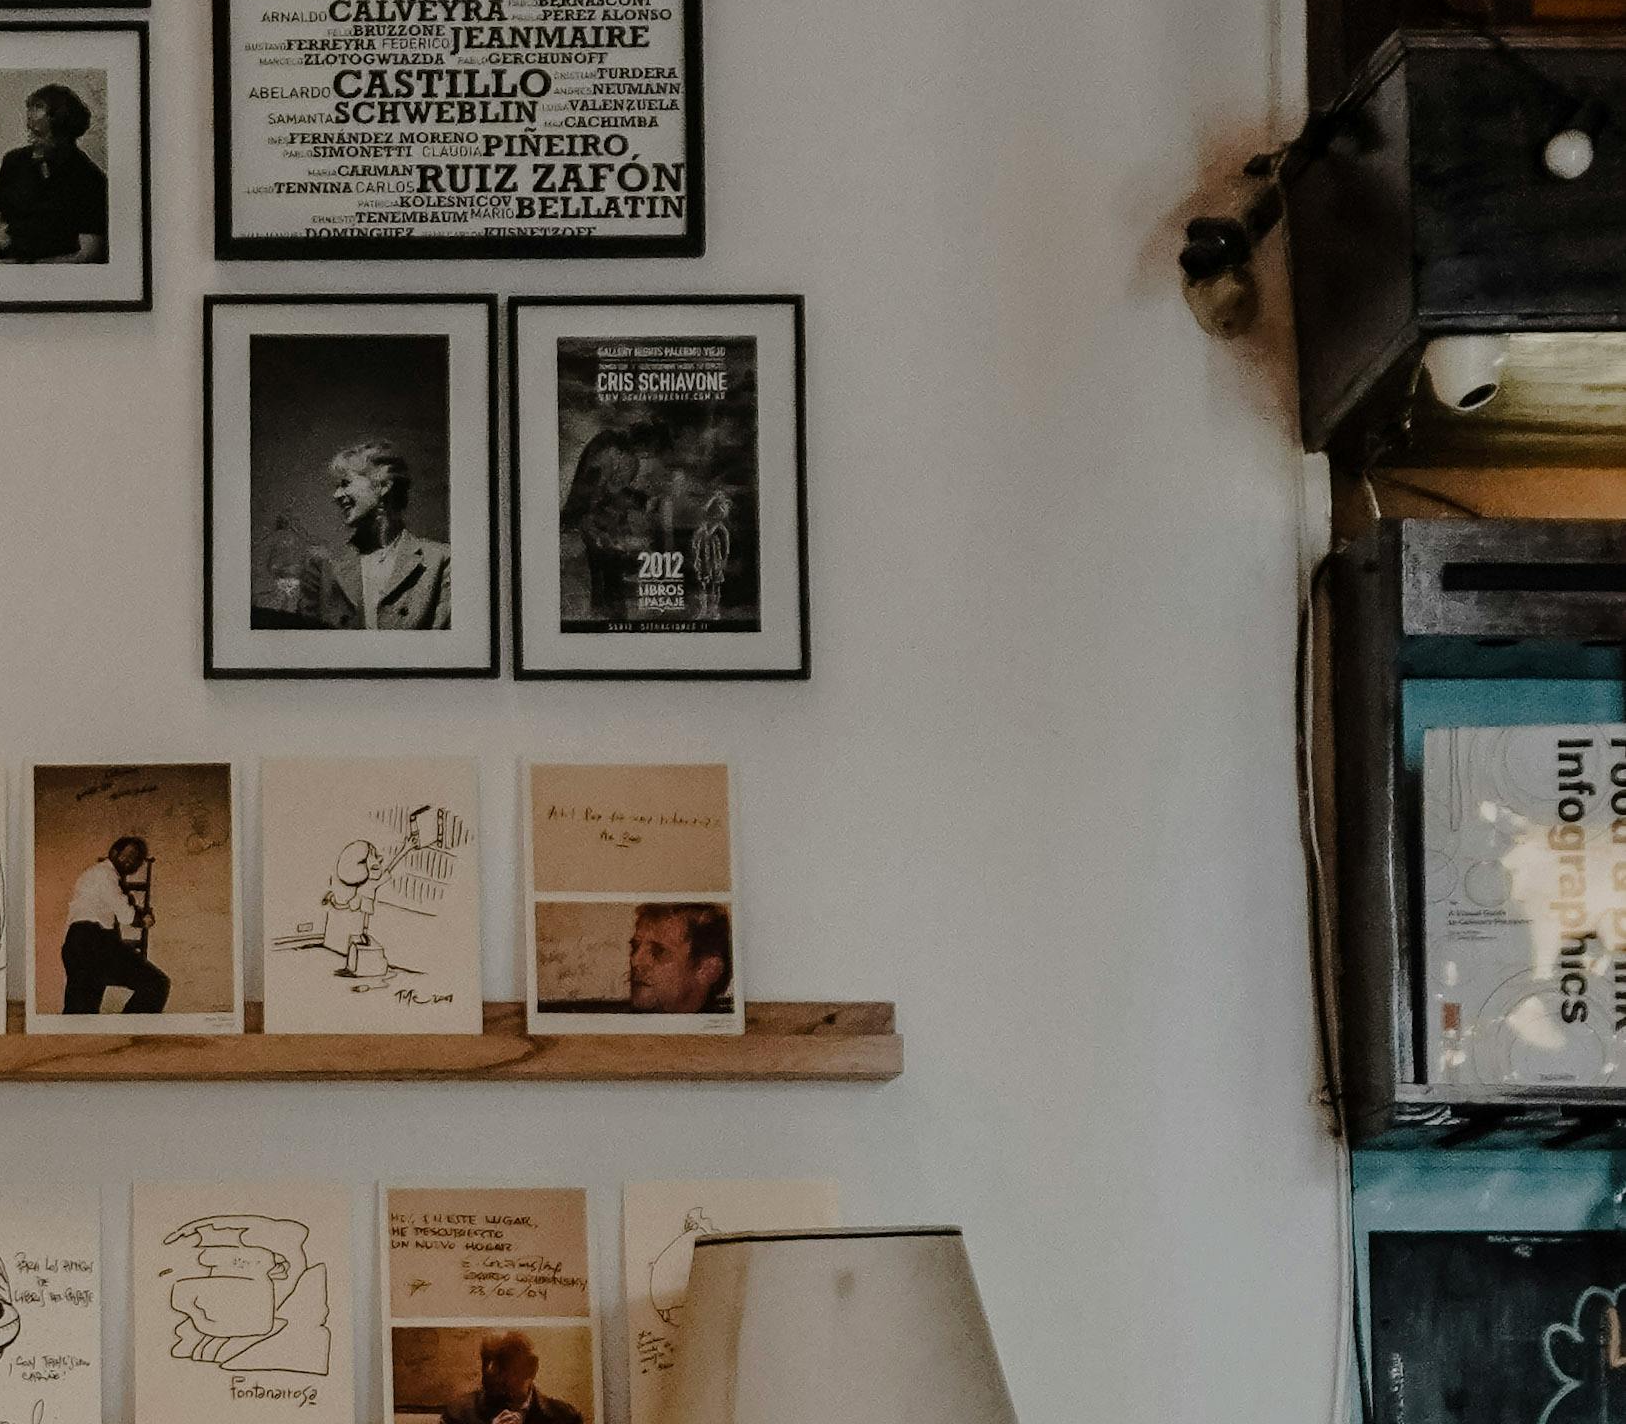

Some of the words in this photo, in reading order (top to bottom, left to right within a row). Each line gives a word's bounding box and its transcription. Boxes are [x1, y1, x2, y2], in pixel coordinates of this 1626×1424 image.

[261, 11, 327, 23] ARNALDO
[328, 0, 508, 23] CALVEYRA
[601, 8, 672, 21] ALONSO
[286, 39, 376, 51] FERREYRA
[450, 25, 650, 55] JEANMAIRE
[353, 24, 446, 37] BRUZZONE
[248, 86, 331, 99] ABELARDO
[333, 68, 552, 98] CASTILLO
[592, 82, 682, 95] NEUMANN
[268, 113, 335, 125] SAMANTA
[334, 100, 538, 124] SCHWEBLIN
[568, 98, 680, 111] VALENZUELA
[564, 115, 660, 128] CACHIMBA
[313, 145, 412, 158] SIMONETTI
[481, 126, 629, 157] PIÑEIRO
[399, 131, 479, 144] MORENO
[337, 164, 413, 176] CARMAN
[416, 163, 518, 193] RUIZ
[532, 153, 684, 193] ZAFÓN
[275, 181, 353, 194] TENNINA
[355, 181, 416, 194] CARLOS
[355, 211, 469, 223] TENEMBAUM
[515, 195, 685, 219] BELLATIN
[400, 195, 512, 209] KOLESNICOV
[597, 372, 634, 392] CRIS
[638, 372, 728, 392] SCHIAVONE
[637, 551, 685, 578] 2012
[638, 583, 685, 596] LIBROS
[1547, 738, 1597, 1023] Infographics
